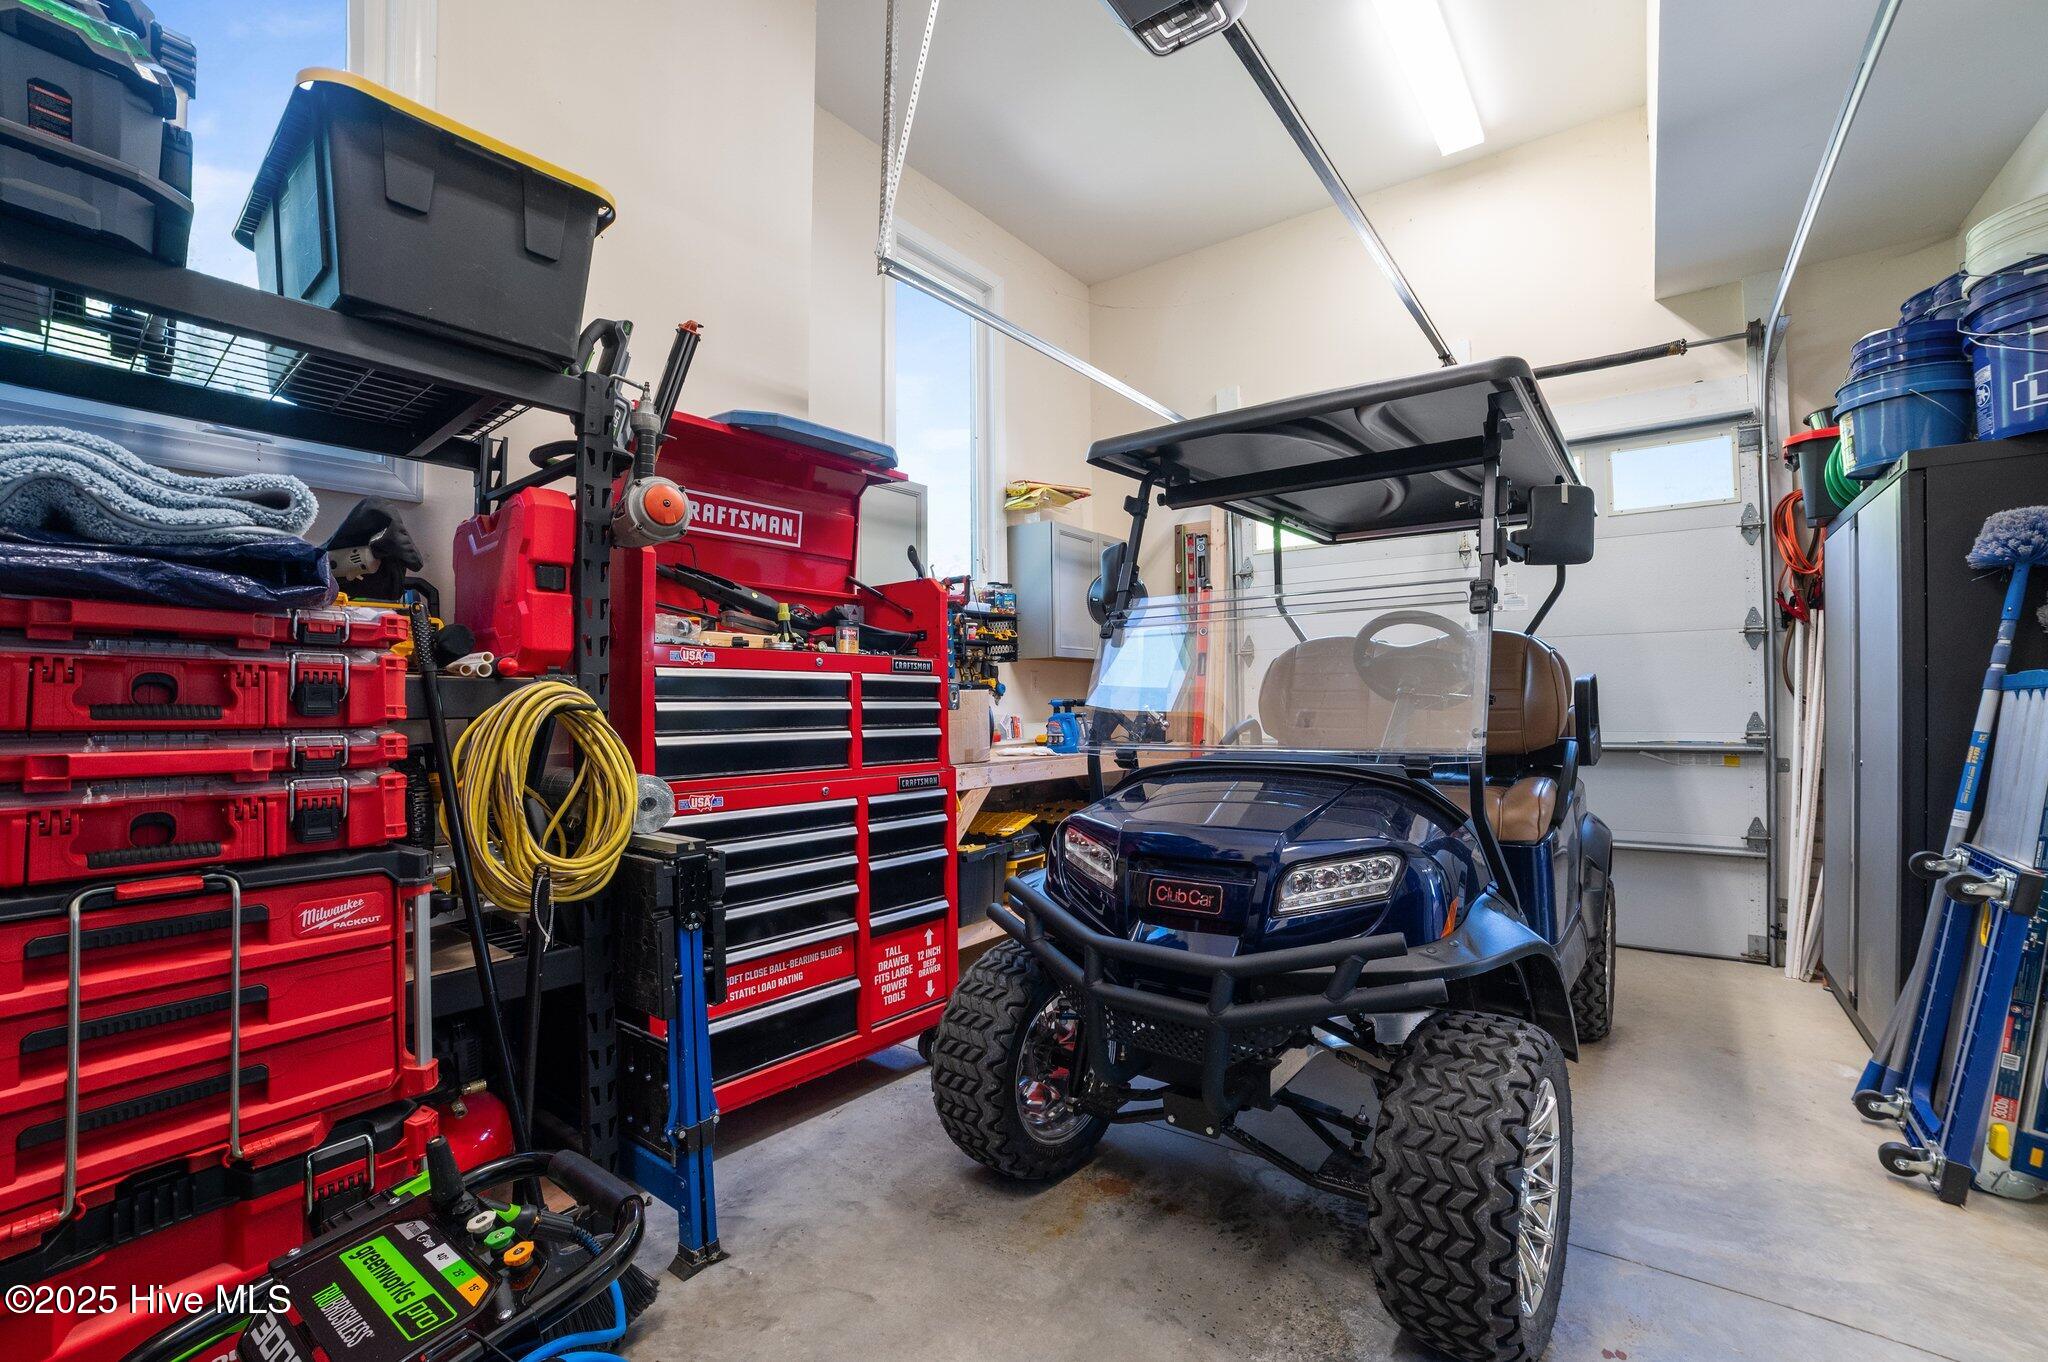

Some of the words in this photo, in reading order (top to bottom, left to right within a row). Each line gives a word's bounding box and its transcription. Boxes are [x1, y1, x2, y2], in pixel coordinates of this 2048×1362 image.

[688, 500, 793, 536] RAFTSMAN
[682, 650, 702, 661] USA
[894, 661, 931, 671] CRAFTSMAN
[901, 777, 938, 788] CRAFTSMAN
[691, 797, 711, 808] USA
[1156, 885, 1187, 903] Club
[1188, 889, 1214, 908] Car
[298, 898, 365, 928] Milwaukee
[333, 915, 381, 929] PACKOUT
[885, 945, 902, 958] TALL
[917, 950, 925, 961] 12
[925, 945, 941, 959] INCH
[744, 967, 768, 982] CLOSE
[769, 953, 820, 975] BALL-BEARING
[820, 945, 843, 960] SLIDES
[878, 954, 910, 972] DRAWER
[918, 963, 941, 978] DRAWER
[922, 957, 937, 969] DEEP
[874, 971, 890, 986] FITS
[891, 964, 914, 980] LARGE
[729, 986, 757, 1001] STATIC
[757, 980, 776, 993] LOAD
[777, 971, 804, 987] RATING
[881, 977, 908, 995] POWER
[883, 990, 906, 1006] TOOLS
[348, 1245, 416, 1305] greenworks
[398, 1299, 440, 1330] pro
[312, 1282, 375, 1348] TRUBRUSHLESS
[251, 1311, 303, 1362] 300
